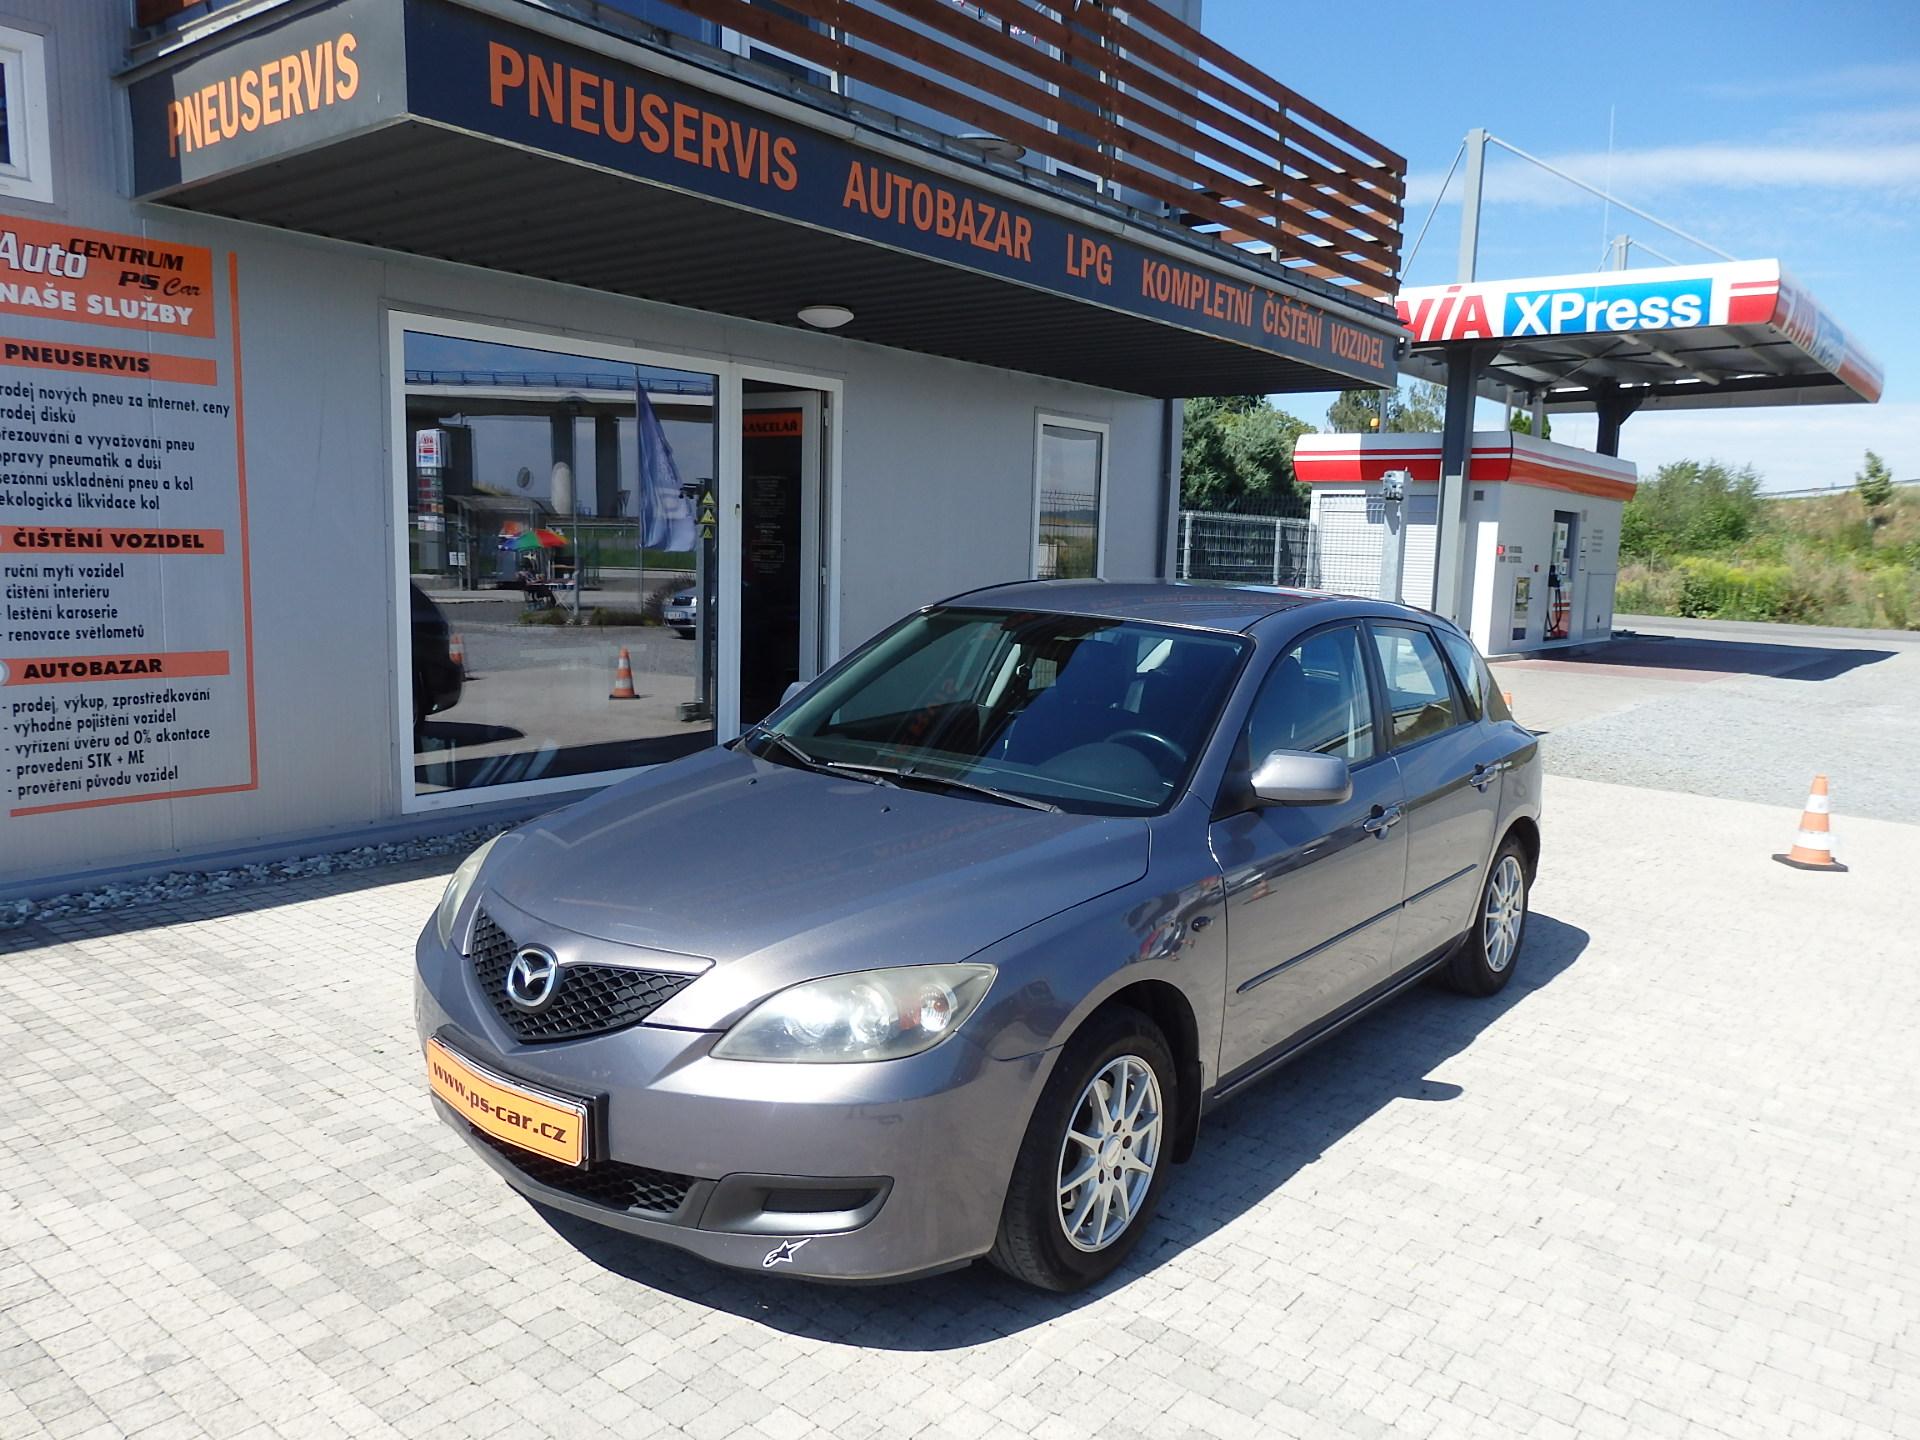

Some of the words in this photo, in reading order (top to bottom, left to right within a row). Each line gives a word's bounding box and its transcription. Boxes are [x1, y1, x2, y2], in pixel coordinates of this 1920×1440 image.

[168, 32, 360, 159] PNEUSERVIS
[488, 40, 798, 192] PNEUSERVIS
[842, 160, 1033, 263] AUTOBAZAR
[1065, 233, 1113, 286] LPG
[1141, 258, 1255, 328] KOMPLETNÍ
[1262, 290, 1325, 349] ČIŠTĚNÍ
[1330, 323, 1385, 370] VOZIDEL
[0, 230, 88, 279] Auto
[68, 238, 184, 271] CENTRUM
[118, 271, 161, 290] PS
[163, 277, 201, 297] Car
[0, 281, 76, 312] NAŠE
[87, 294, 193, 326] SLUŽBY
[1512, 292, 1705, 335] XPress
[4, 343, 150, 373] PNEUSERVIS
[0, 382, 35, 402] rodej
[39, 386, 87, 405] nových
[92, 394, 123, 407] pneu
[128, 395, 143, 407] za
[203, 402, 230, 418] ceny
[0, 403, 36, 425] rodej
[0, 426, 69, 444] řezouvání
[75, 435, 82, 445] a
[166, 438, 195, 453] pneu
[49, 451, 119, 468] pneumatik
[124, 458, 132, 468] a
[128, 478, 158, 492] pneu
[163, 481, 170, 490] a
[175, 476, 193, 491] kol
[78, 493, 136, 509] likvidace
[140, 494, 160, 510] kol
[13, 528, 103, 547] ČIŠTĚNÍ
[111, 534, 204, 548] VOZIDEL
[79, 563, 124, 578] vozidel
[56, 604, 118, 619] karoserie
[8, 628, 70, 641] renovace
[24, 659, 162, 679] AUTOBAZAR
[64, 693, 108, 711] výkup,
[133, 708, 176, 724] vozidel
[114, 730, 129, 746] od
[134, 728, 151, 744] 0%
[156, 727, 210, 743] akontace
[87, 754, 112, 769] STK
[128, 750, 145, 765] ME
[136, 765, 178, 782] vozidel
[433, 1062, 567, 1144] www.ps-car.cz
